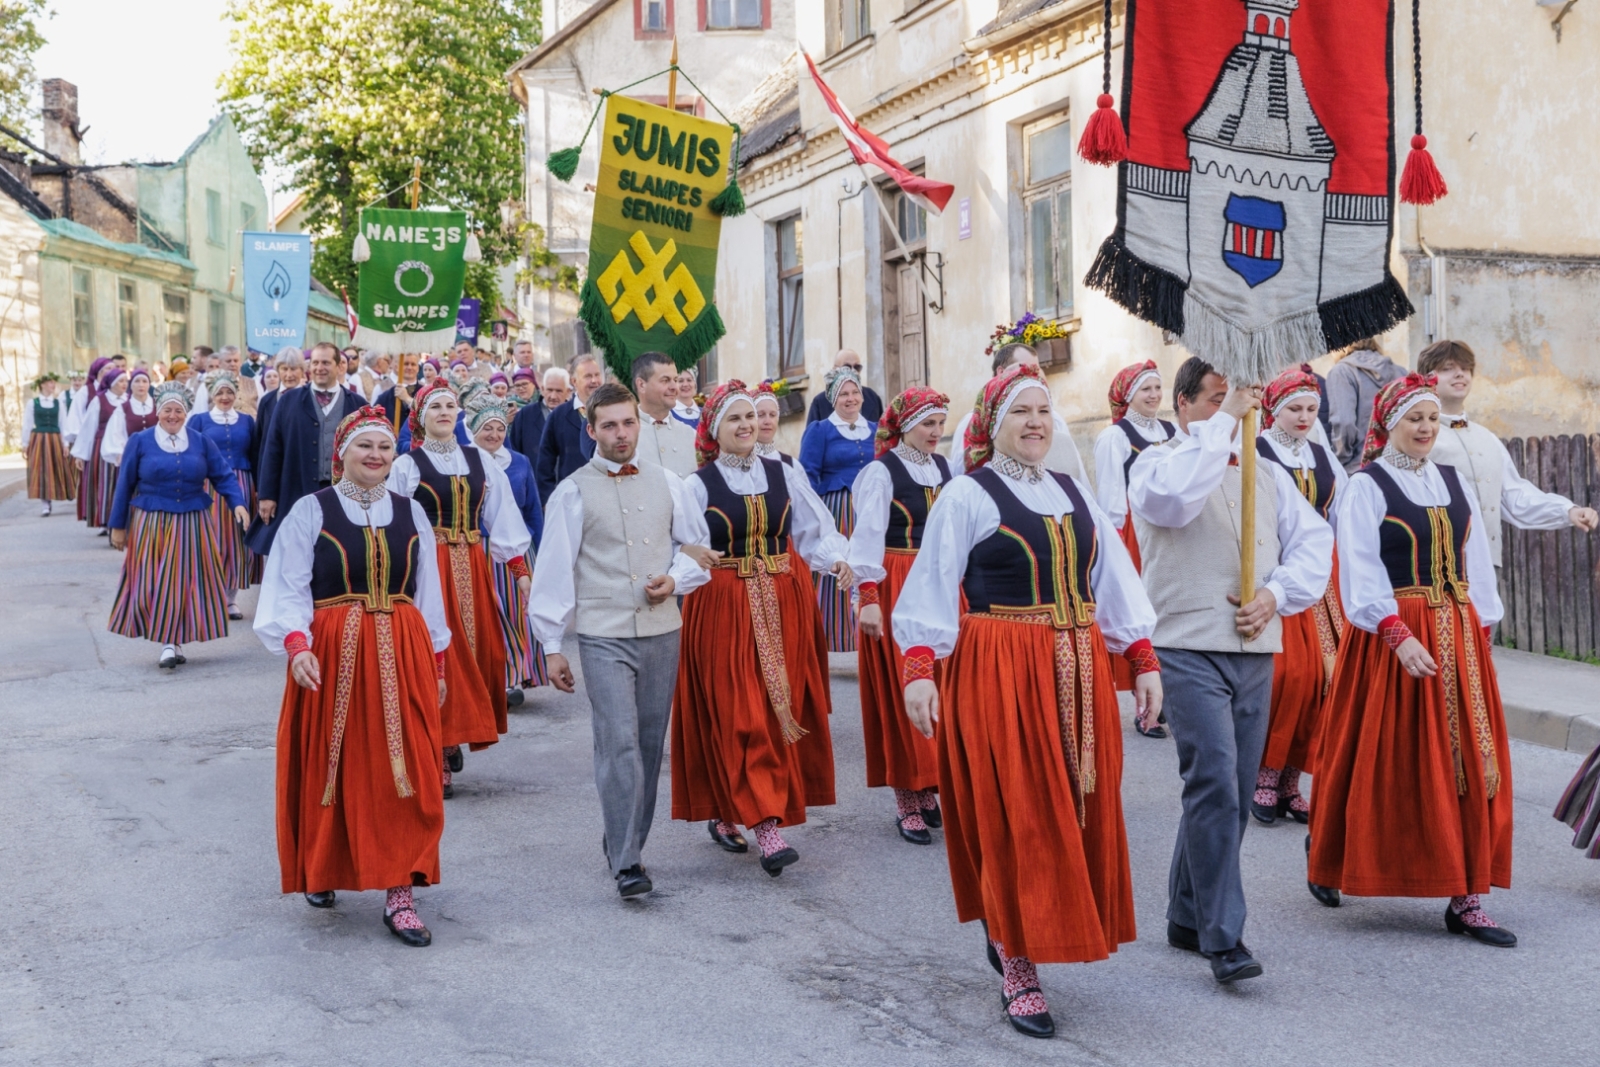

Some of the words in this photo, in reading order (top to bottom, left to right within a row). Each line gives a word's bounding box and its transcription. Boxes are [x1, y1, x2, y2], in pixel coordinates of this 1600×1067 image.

[613, 113, 720, 177] JUMIS
[618, 169, 703, 208] SLAMPES
[621, 196, 693, 232] SENIORI
[254, 241, 300, 252] SLAMPE
[366, 222, 461, 251] NAMEJS
[373, 303, 450, 319] SLAMPES
[254, 327, 297, 338] LAISMA
